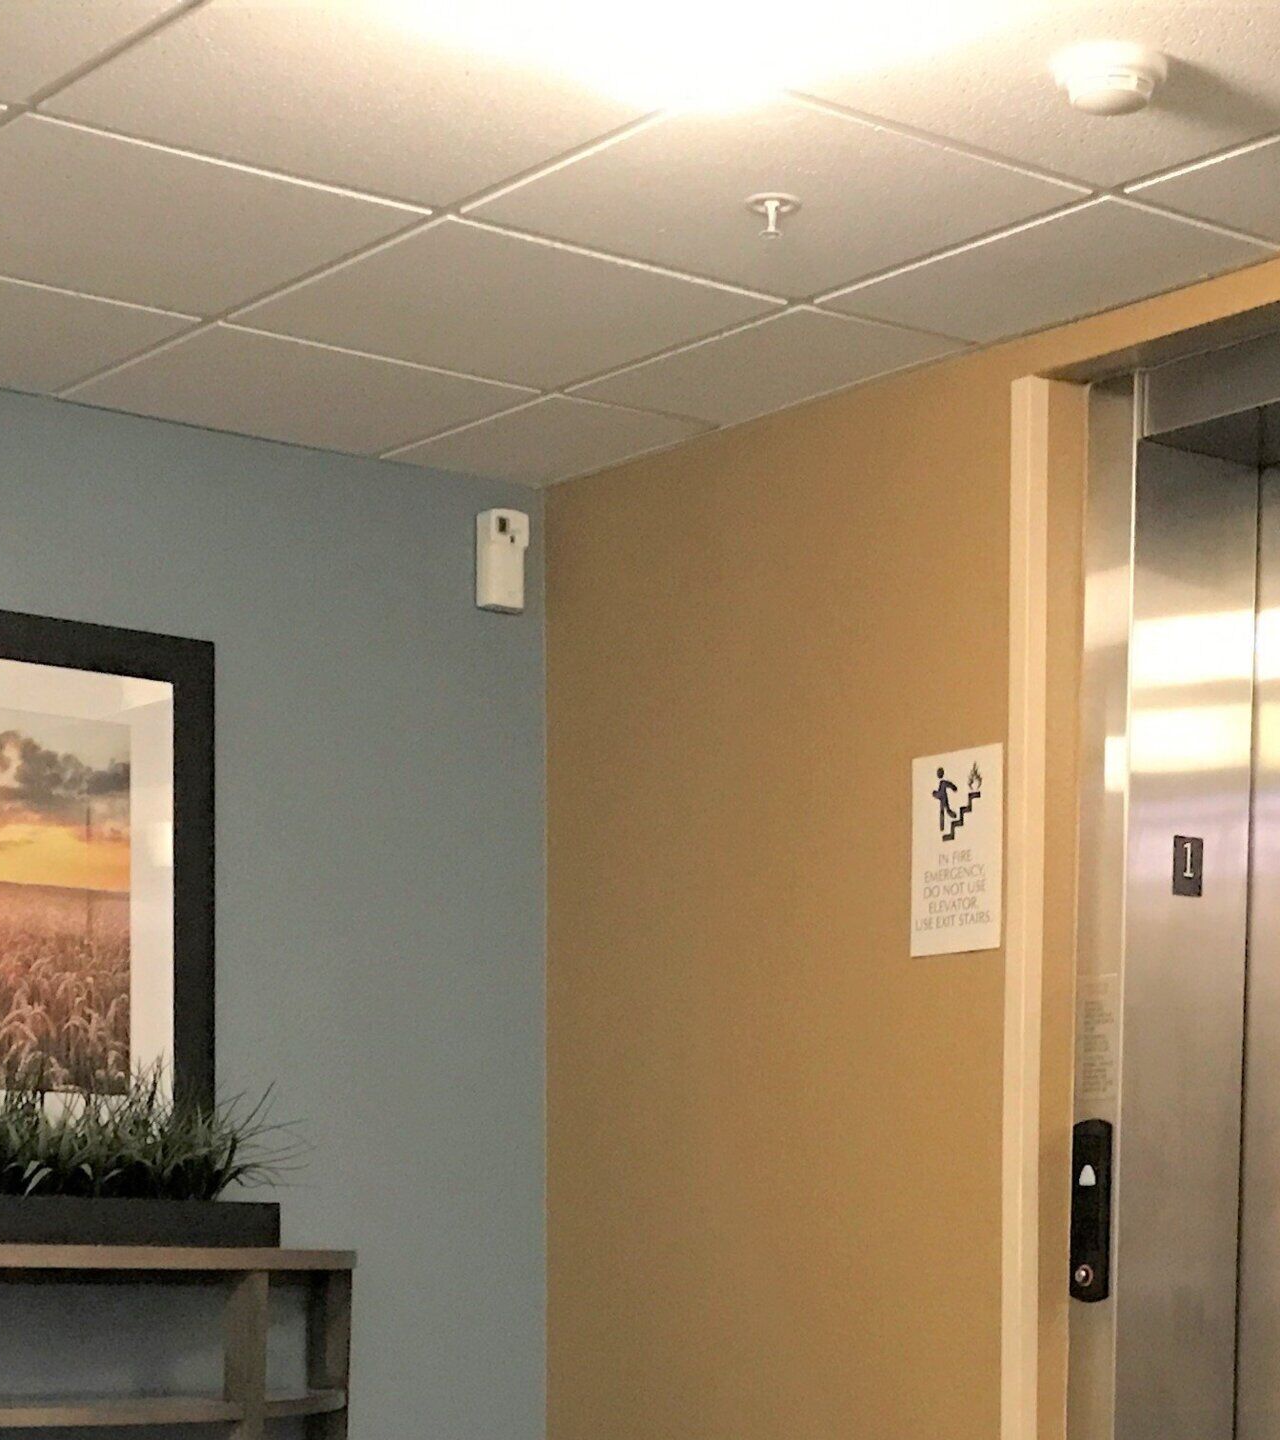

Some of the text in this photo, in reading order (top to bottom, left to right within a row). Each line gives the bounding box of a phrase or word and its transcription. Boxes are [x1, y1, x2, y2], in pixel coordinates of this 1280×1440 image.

[938, 849, 973, 866] IN FIRE
[1183, 842, 1195, 878] 1
[923, 879, 986, 899] DO NOT USE
[915, 917, 933, 931] USE
[936, 914, 956, 928] EXIT
